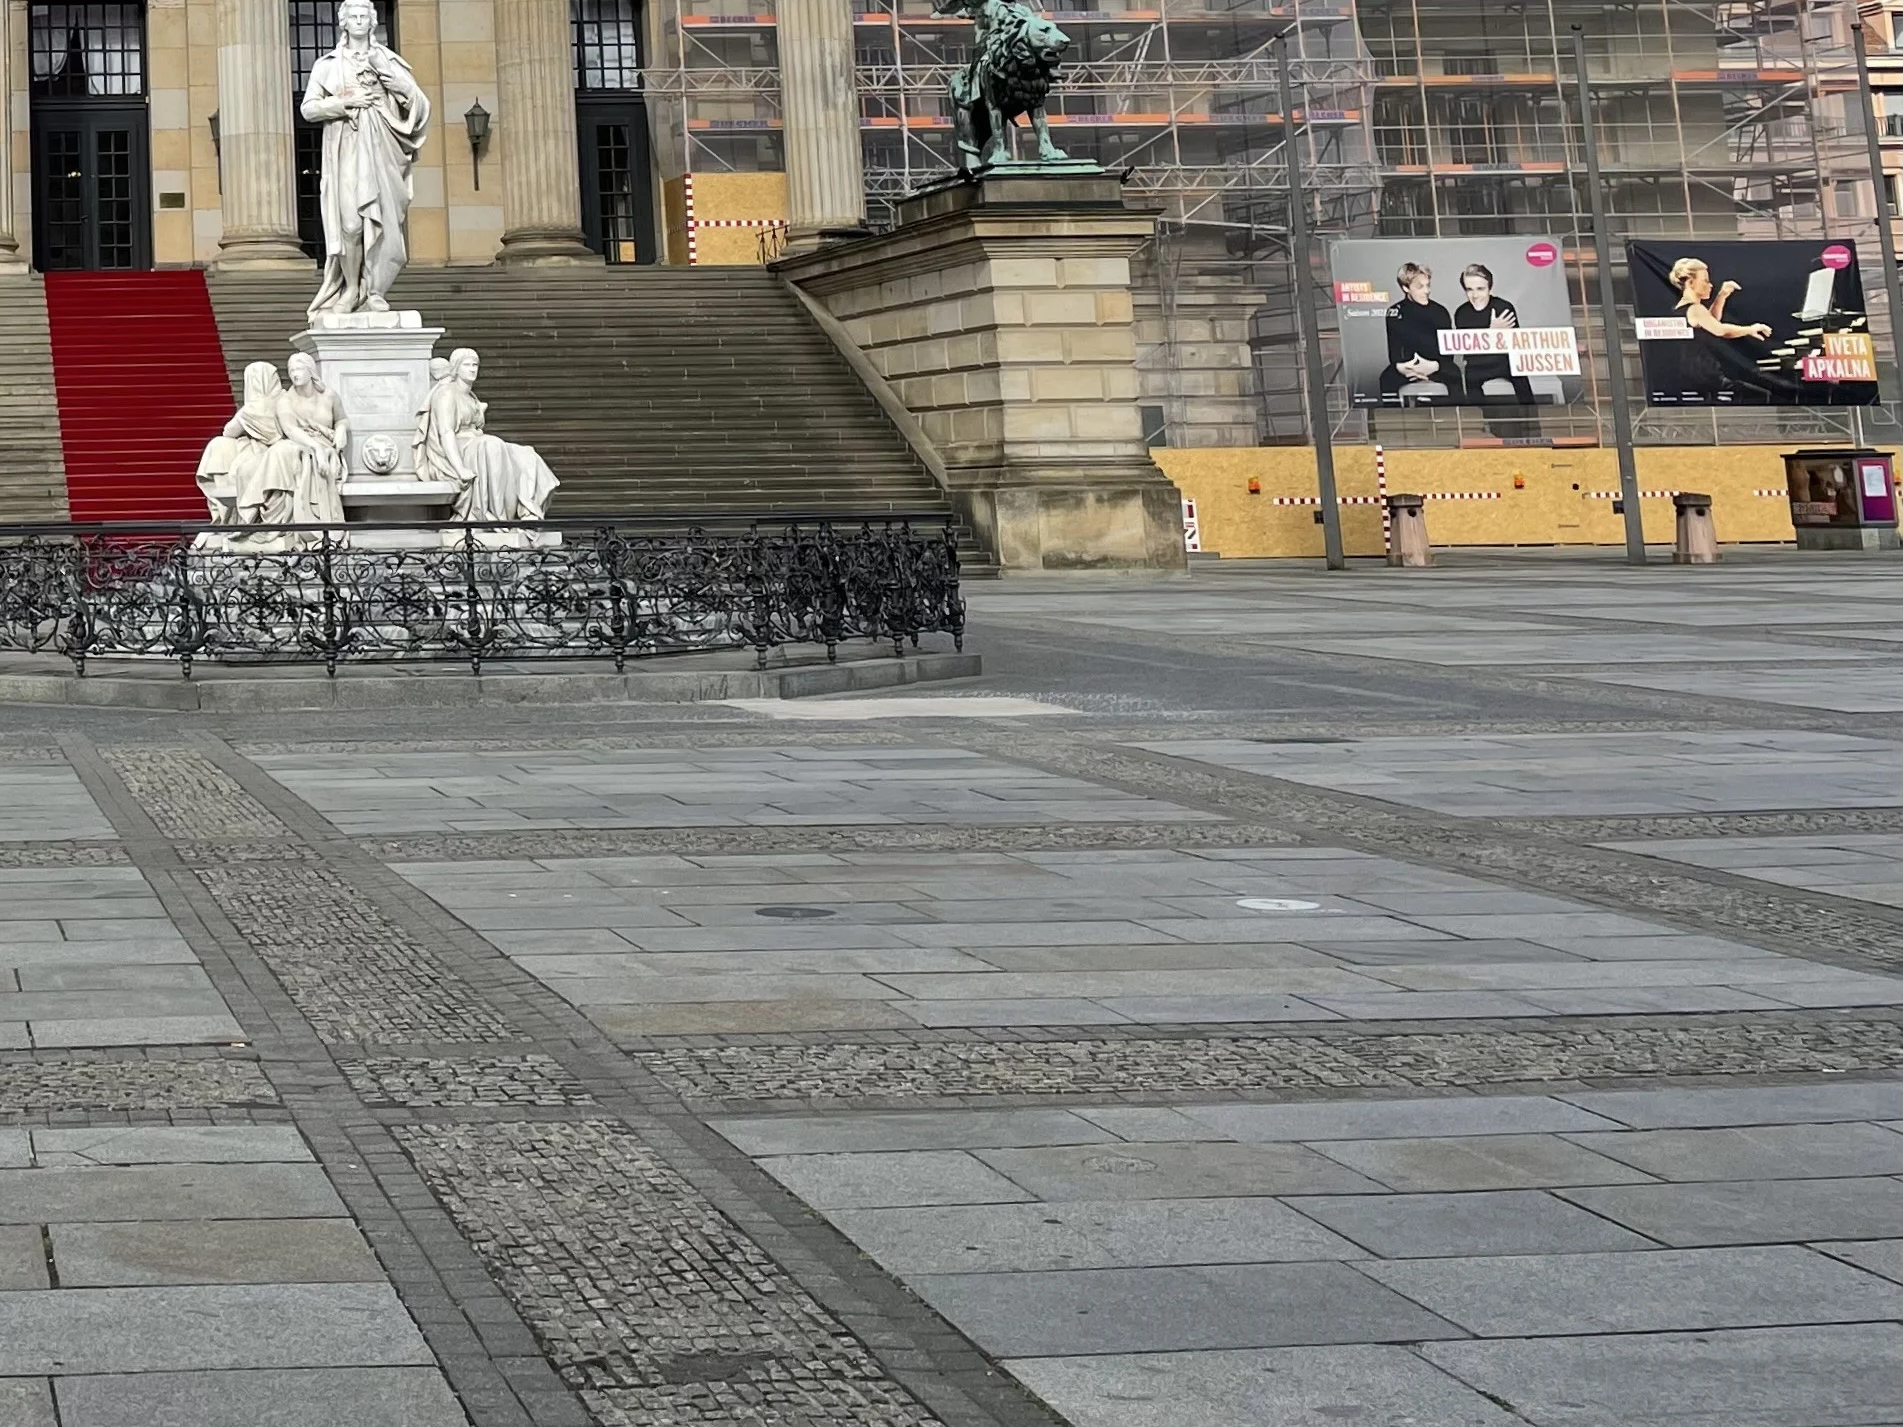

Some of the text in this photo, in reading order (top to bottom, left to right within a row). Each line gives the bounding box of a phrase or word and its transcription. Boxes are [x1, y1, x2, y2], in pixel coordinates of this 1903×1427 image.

[1443, 330, 1571, 352] LUCAS & ARTHUR
[1828, 338, 1868, 356] IVETA
[1516, 353, 1574, 373] JUSSEN
[1807, 359, 1871, 379] APKALNA
